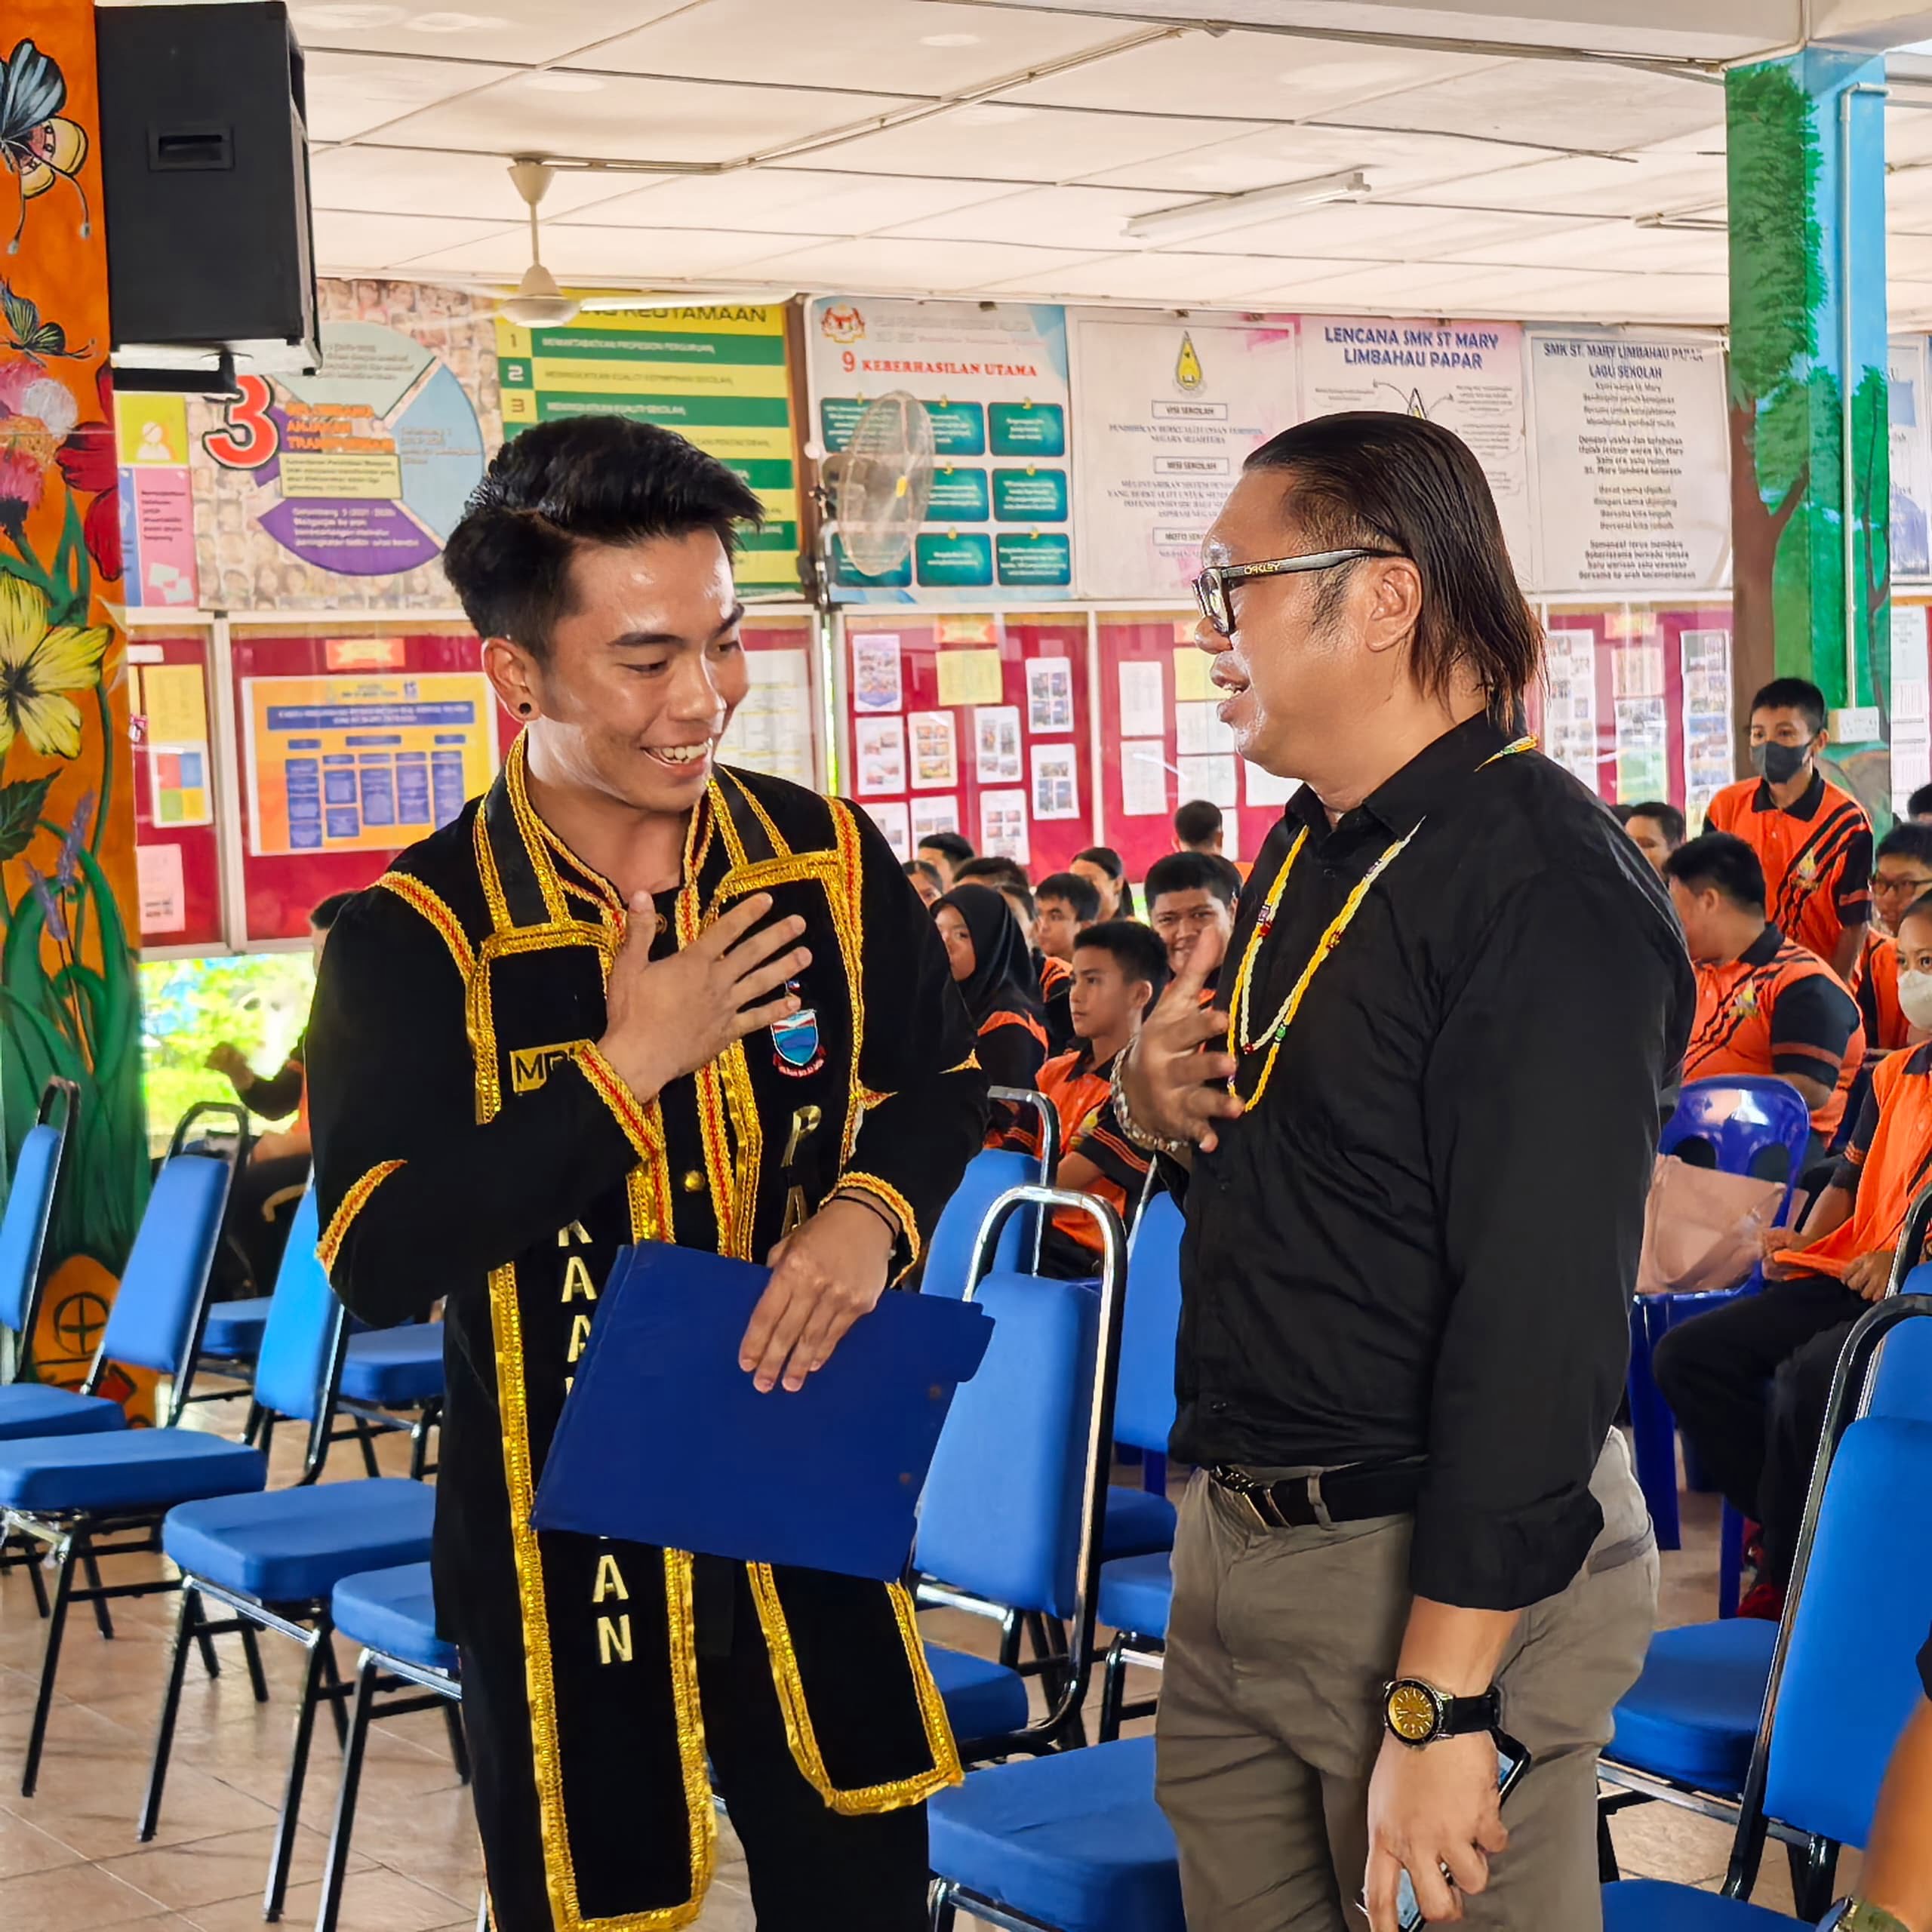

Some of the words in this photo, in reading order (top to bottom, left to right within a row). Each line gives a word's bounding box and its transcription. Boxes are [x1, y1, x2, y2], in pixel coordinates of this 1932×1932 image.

[1324, 326, 1399, 346] LENCANA
[1404, 330, 1432, 346] SMK
[1436, 332, 1453, 347] ST
[1456, 332, 1499, 350] MARY
[1344, 348, 1426, 368] LIMBAHAU
[1430, 351, 1483, 370] PAPAR
[1543, 343, 1567, 356] SMK
[1586, 344, 1616, 359] MARY
[1618, 345, 1669, 361] LIMBAHAU
[841, 350, 857, 373] 9
[862, 359, 981, 375] KEBERHASILAN
[984, 363, 1038, 377] UTAMA
[1589, 364, 1615, 378] LAGU
[1617, 365, 1662, 379] SEKOLAH
[508, 365, 525, 381] 2
[511, 398, 525, 414] 3
[1181, 406, 1214, 415] SEKOLAH
[204, 375, 279, 468] 3
[1183, 461, 1217, 470] SEKOLAH
[1244, 561, 1281, 575] OAKLEY
